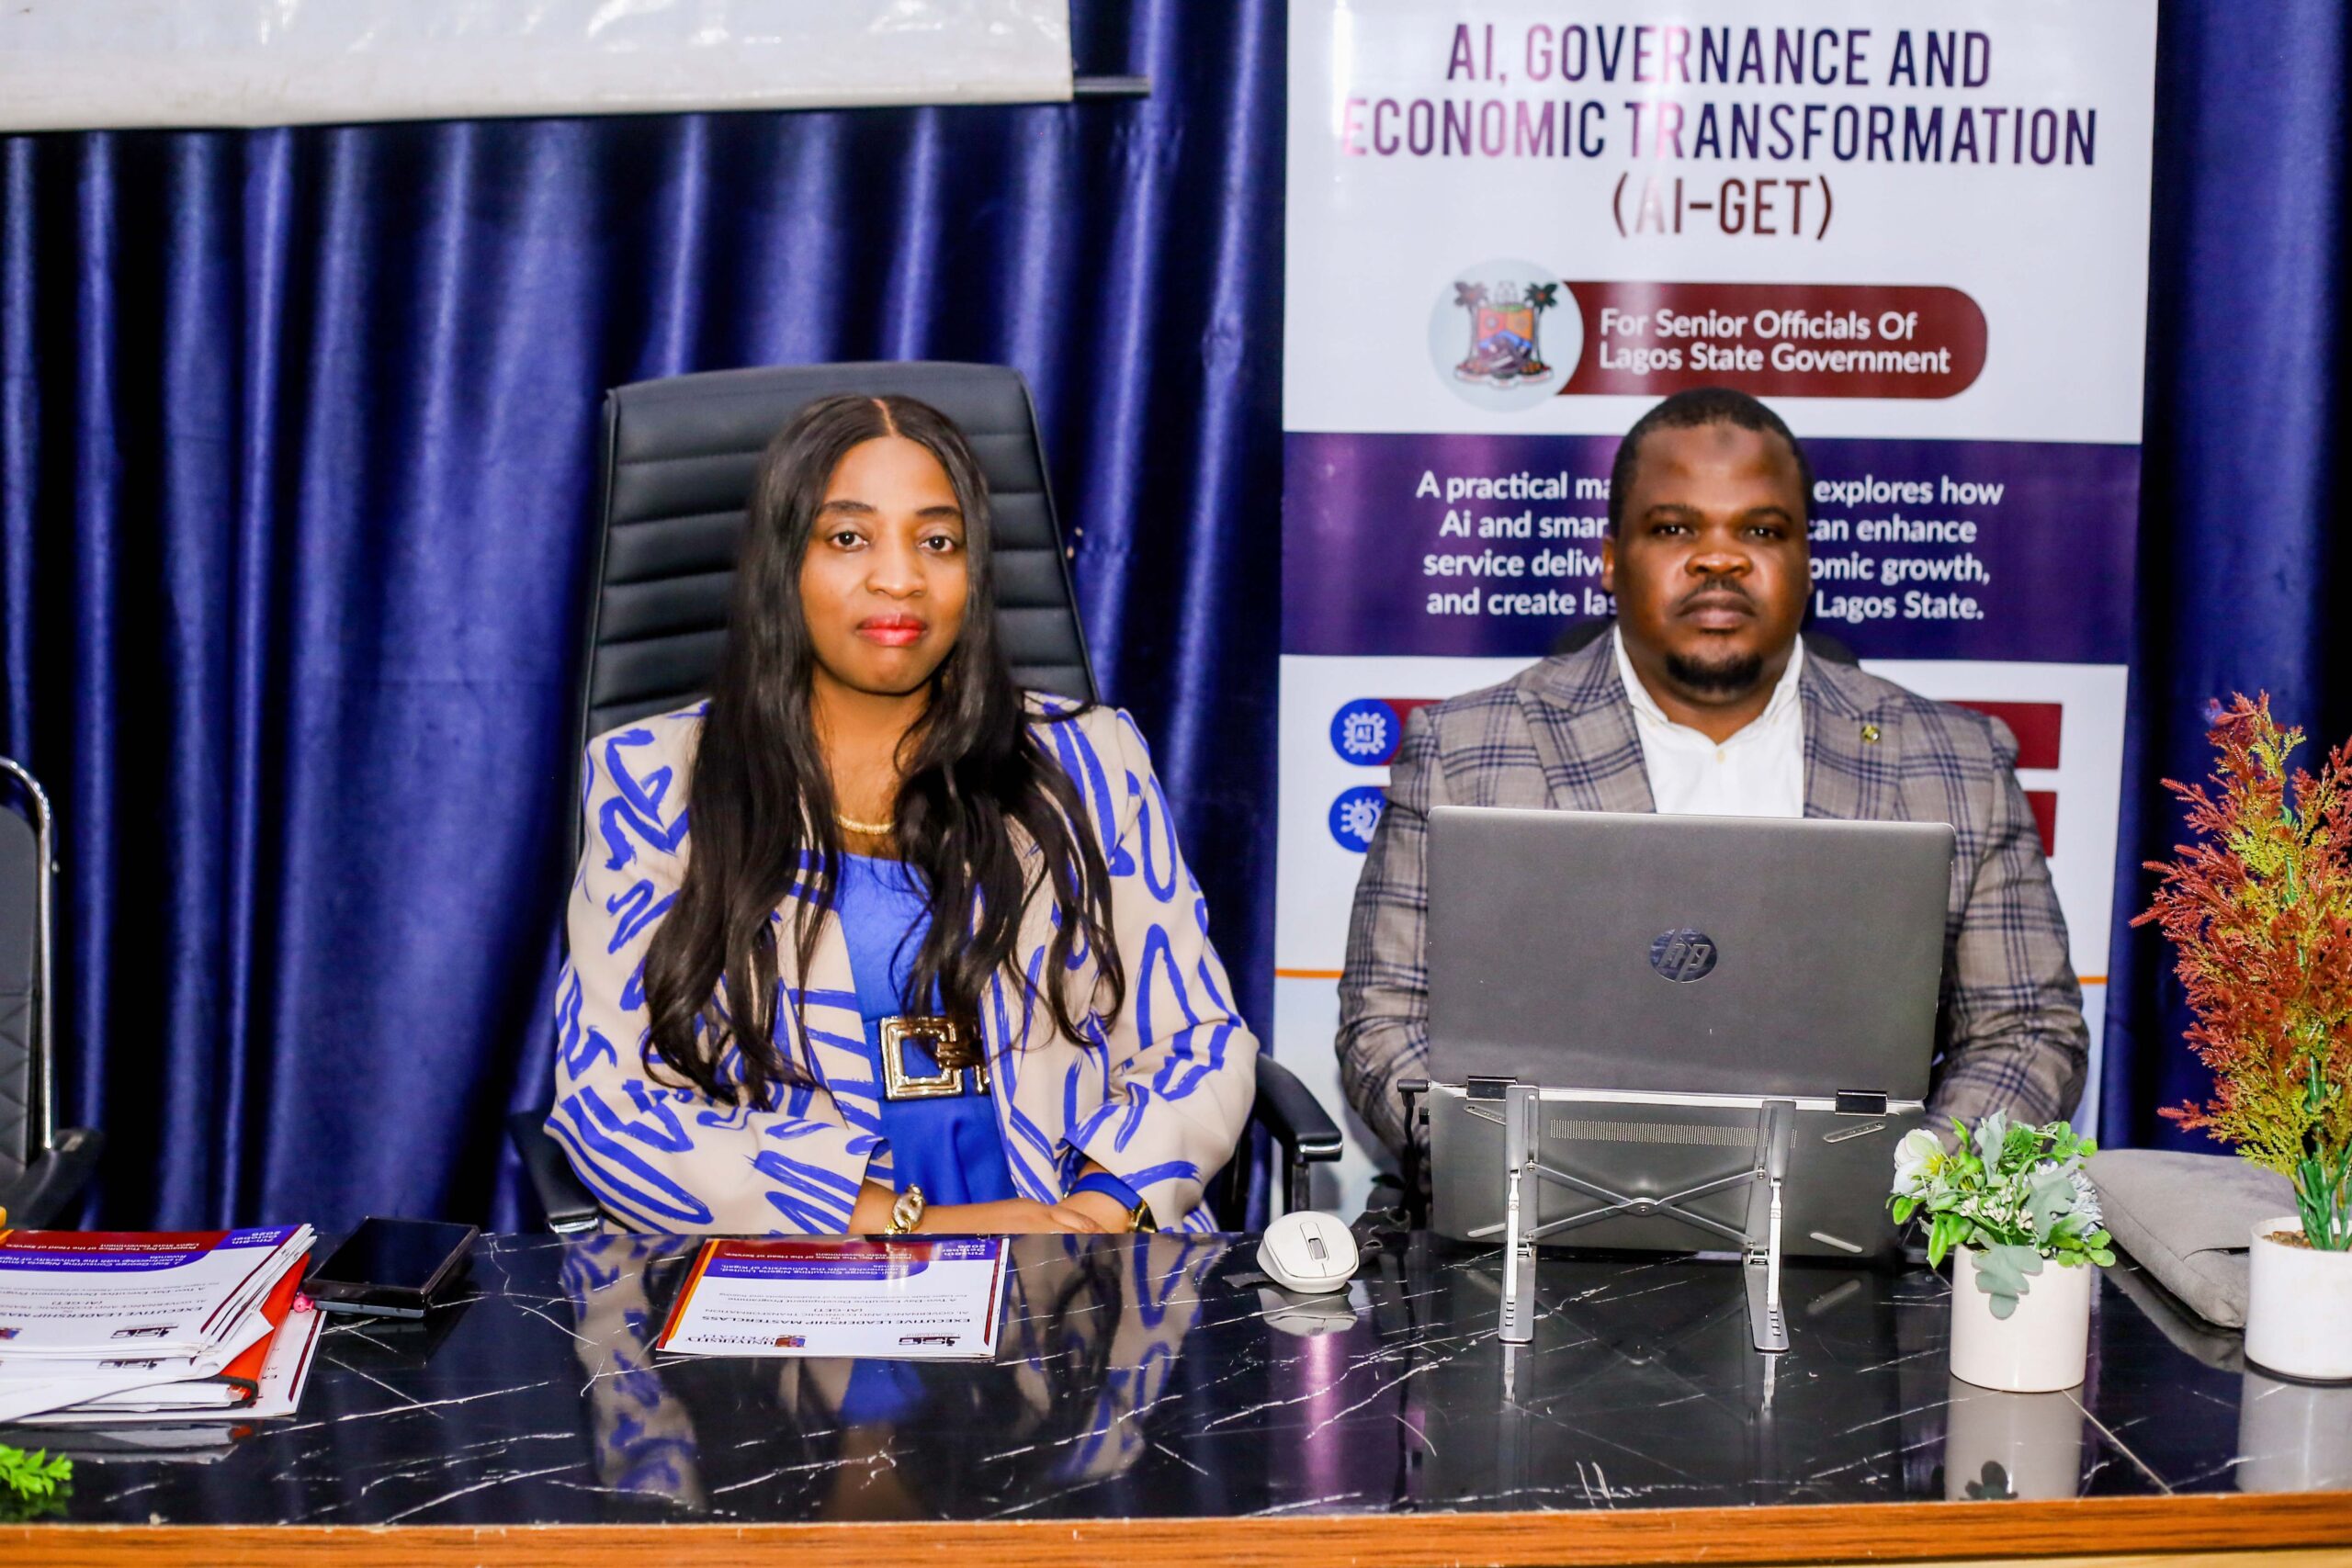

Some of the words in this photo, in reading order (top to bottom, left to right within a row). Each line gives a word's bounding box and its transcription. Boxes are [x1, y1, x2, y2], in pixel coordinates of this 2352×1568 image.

[1446, 24, 1508, 86] AI,
[1526, 24, 1871, 85] GOVERNANCE
[1889, 30, 1990, 88] AND
[1343, 98, 1606, 157] ECONOMIC
[1623, 99, 2097, 166] TRANSFORMATION
[1612, 172, 1832, 241] (AI-GET)
[1600, 308, 1650, 337] For
[1654, 309, 1747, 338] Senior
[1753, 310, 1871, 339] Officials
[1878, 310, 1917, 340] Of
[1600, 342, 1682, 375] Lagos
[1690, 342, 1764, 371] State
[1770, 343, 1951, 374] Government
[1416, 471, 1442, 498] A
[1446, 471, 1568, 504] practical
[1813, 474, 1934, 508] explores
[1940, 475, 2004, 505] how
[1439, 510, 1470, 537] Ai
[1477, 510, 1532, 538] and
[1538, 517, 1609, 538] smar
[1856, 513, 1977, 543] enhance
[1423, 548, 1525, 577] service
[1531, 548, 1604, 577] deliv
[1809, 551, 1875, 581] omic
[1881, 553, 1990, 586] growth,
[1426, 586, 1480, 615] and
[1487, 589, 1577, 615] create
[1815, 590, 1896, 624] Lagos
[1903, 591, 1984, 620] State.
[1657, 927, 1713, 984] hp
[701, 1315, 802, 1325] MASTERCLASS
